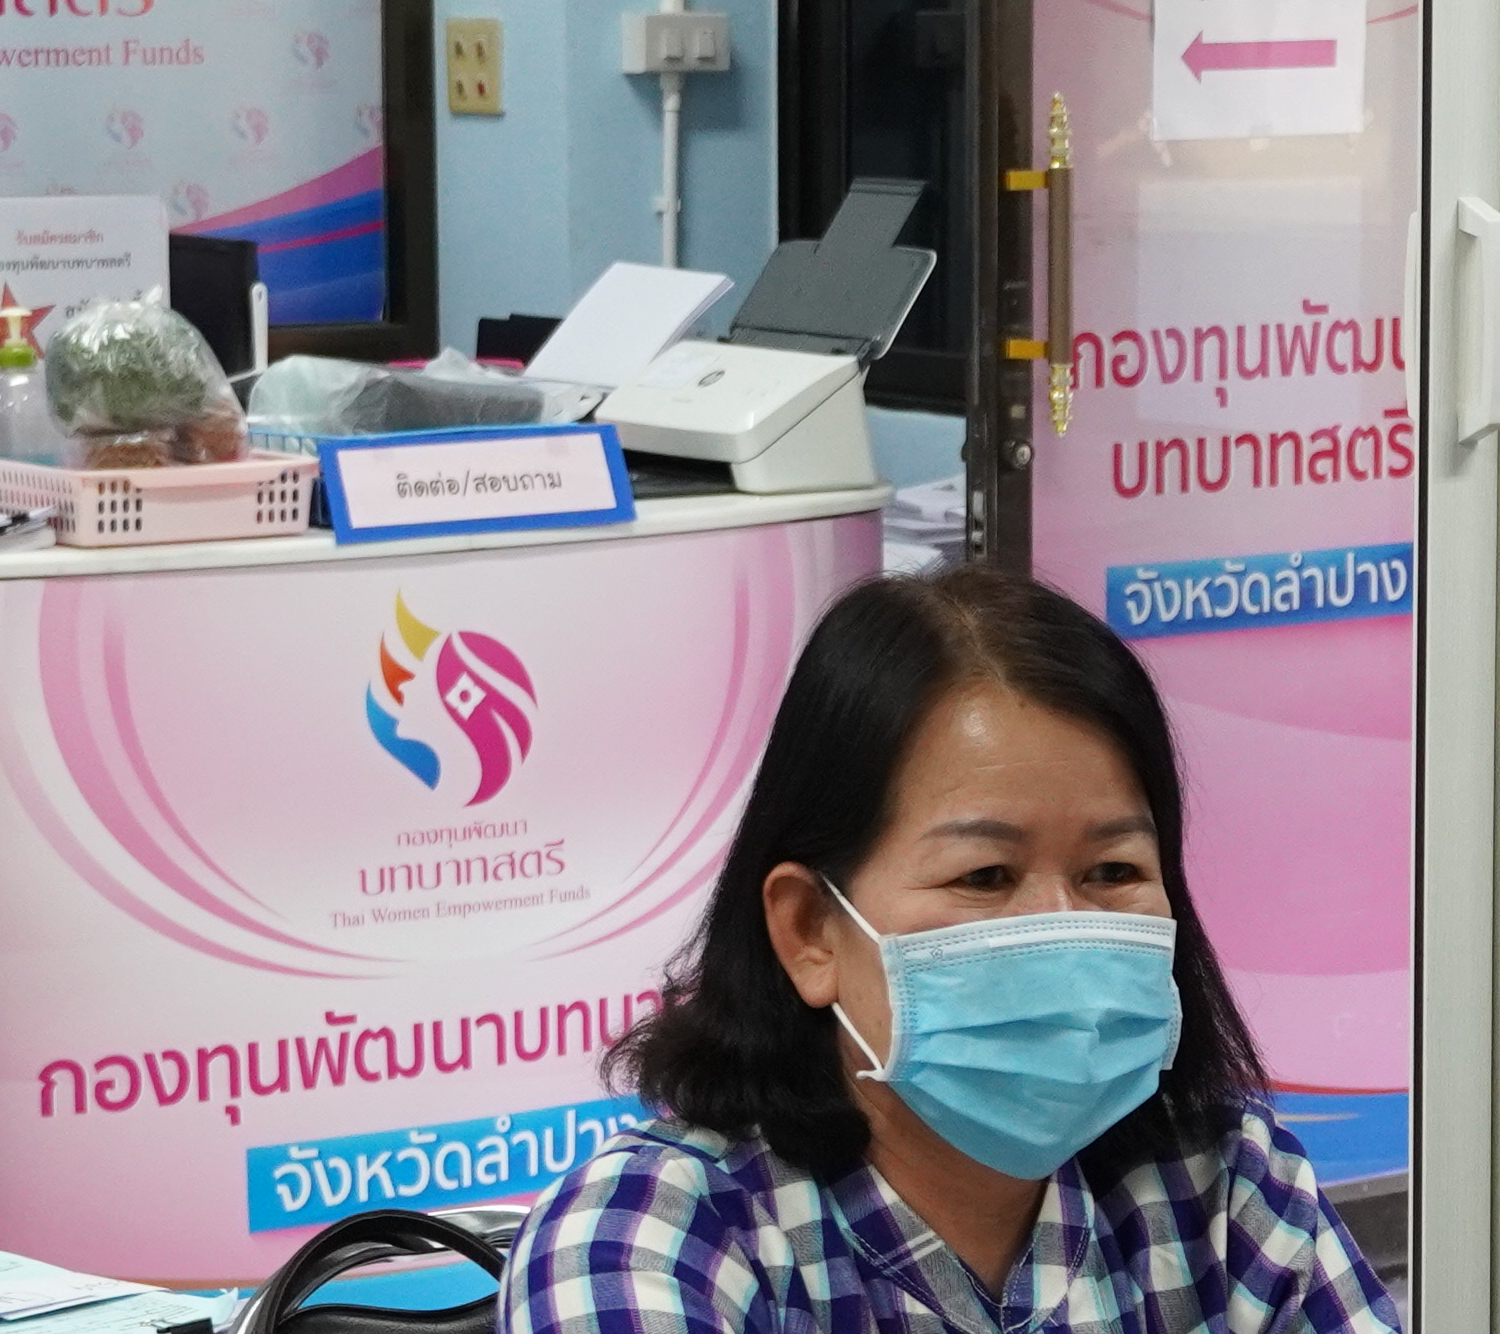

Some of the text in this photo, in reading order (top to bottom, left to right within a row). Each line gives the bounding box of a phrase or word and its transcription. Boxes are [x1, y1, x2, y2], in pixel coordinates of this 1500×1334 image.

[122, 39, 206, 69] Funds
[396, 470, 563, 498] ติดต่อ/สอบถาม
[1123, 550, 1408, 626] จังหวัดลำปาง
[396, 819, 529, 848] กองทุนพัฒนา
[358, 838, 567, 897] บทบาทสตรี
[330, 884, 592, 930] Thai Women Empowerment Funds
